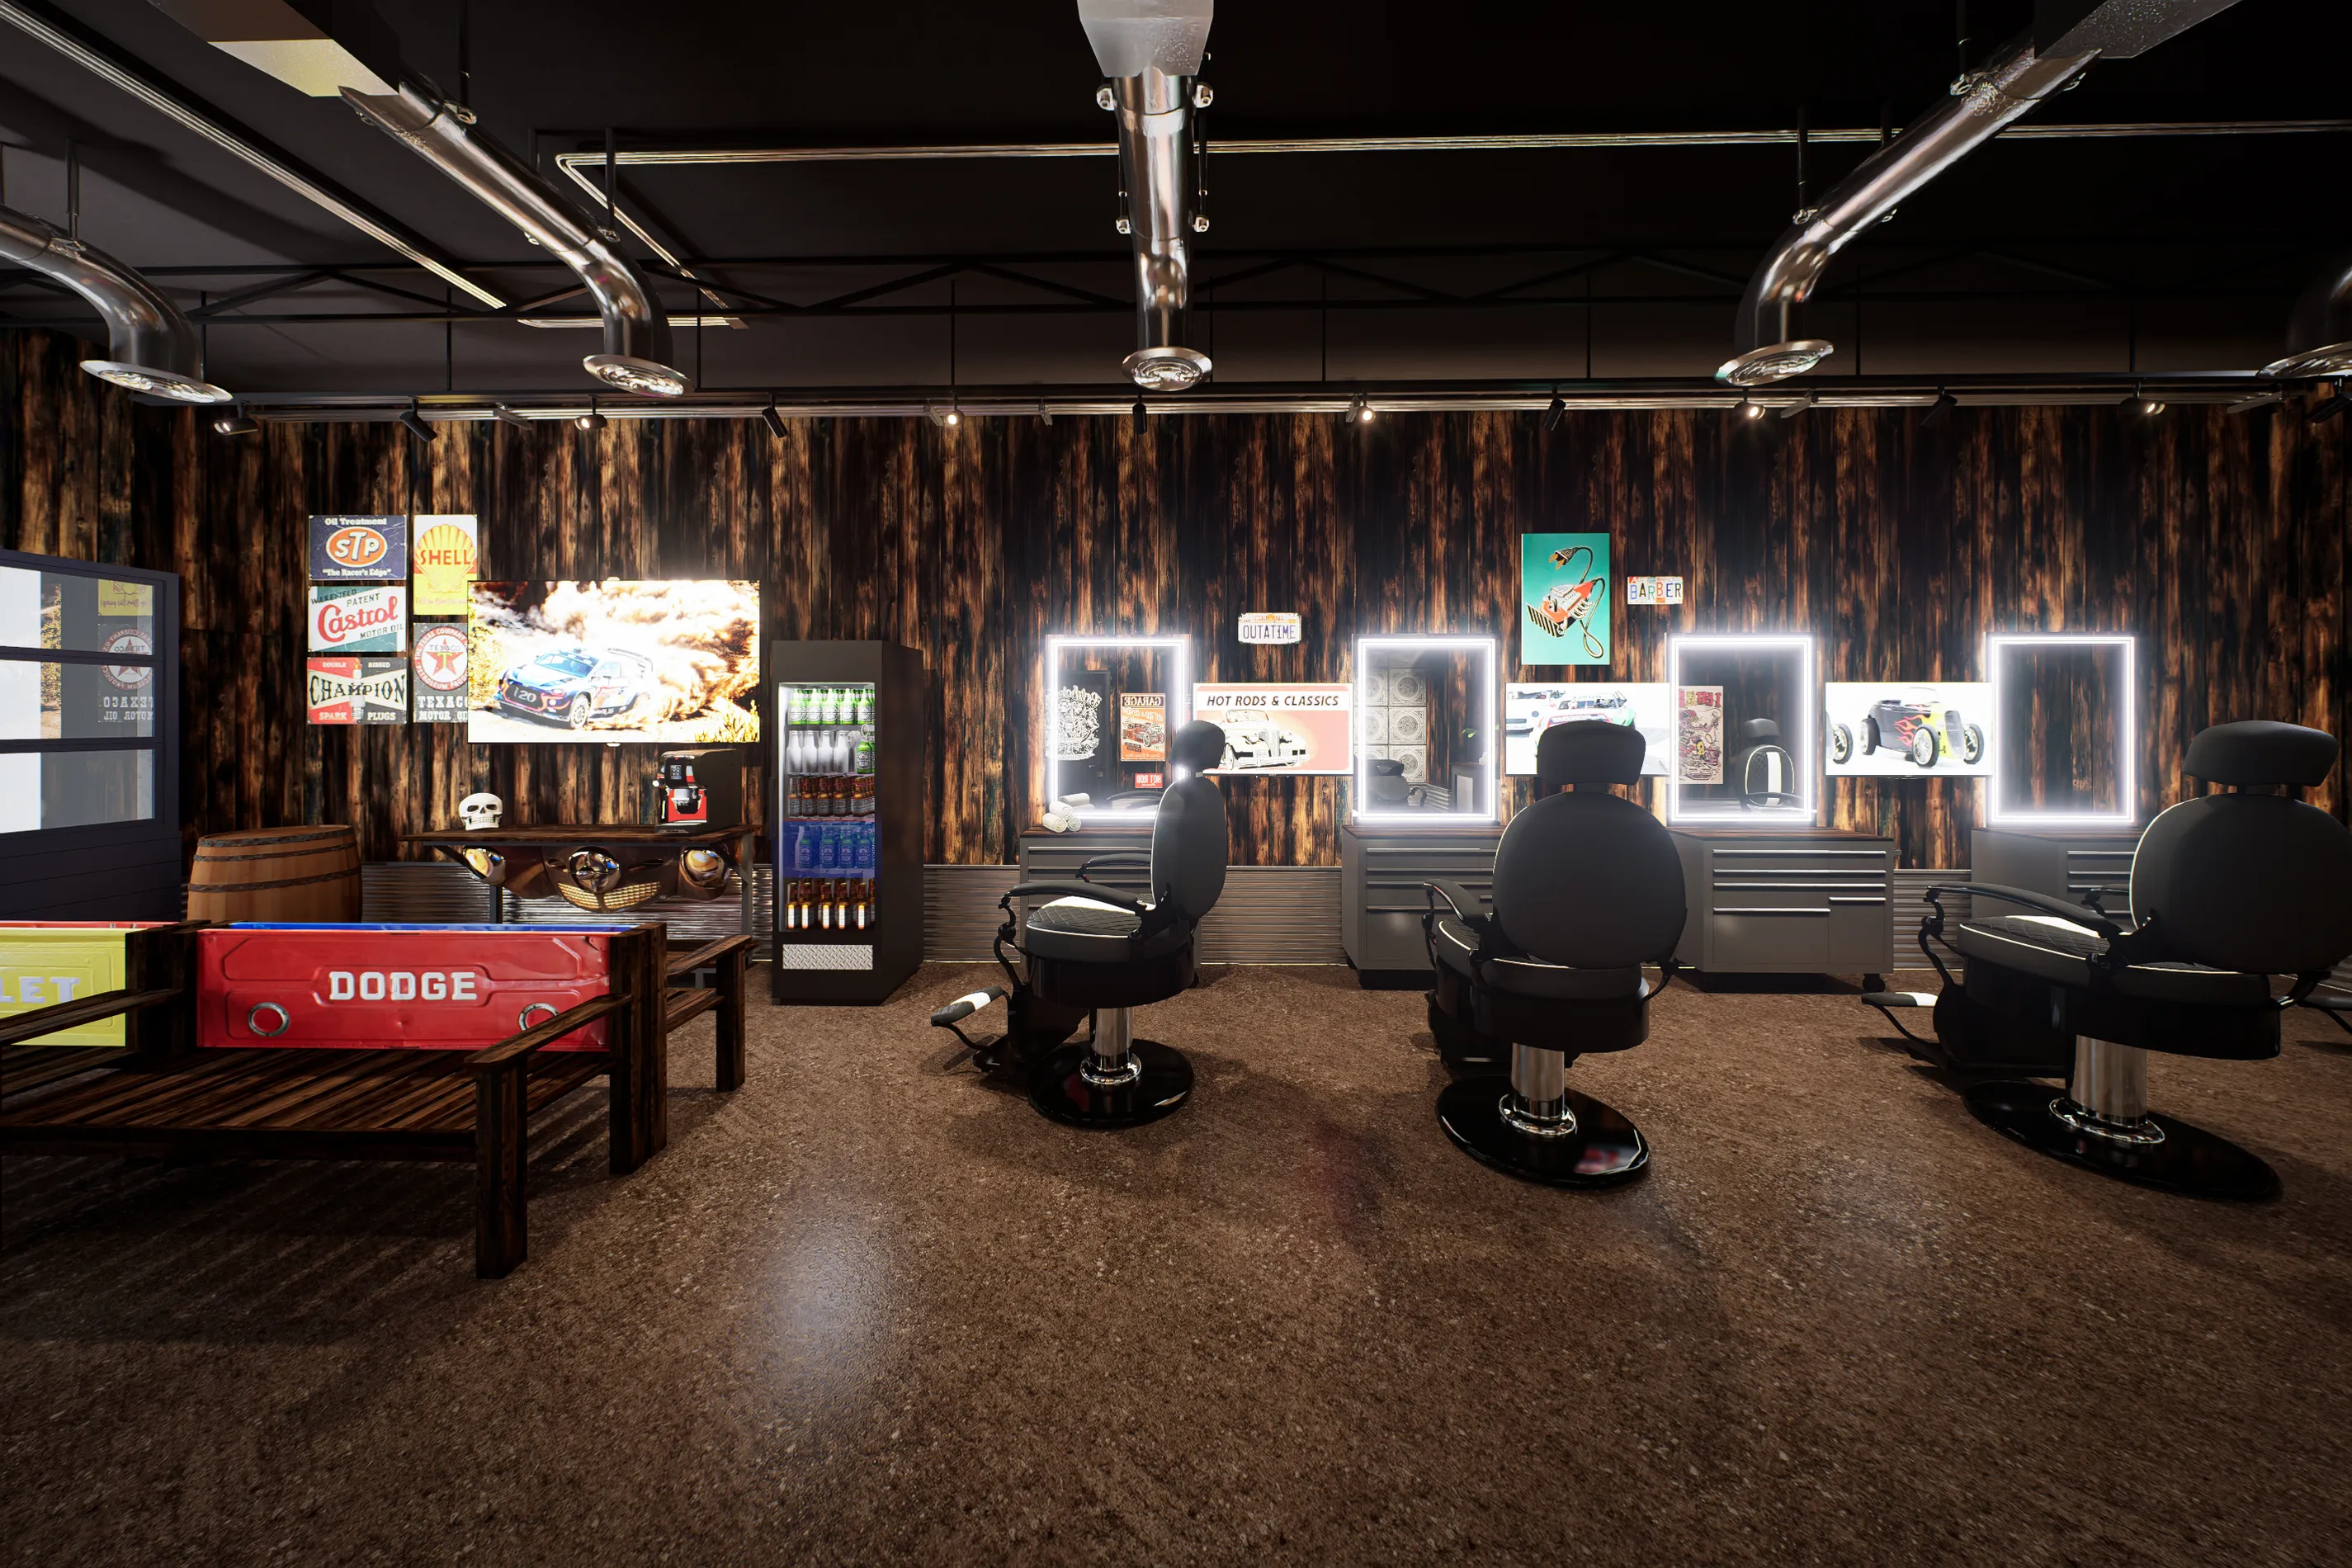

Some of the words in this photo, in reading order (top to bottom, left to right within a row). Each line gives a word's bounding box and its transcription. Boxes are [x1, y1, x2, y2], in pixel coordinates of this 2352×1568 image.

[334, 531, 380, 560] STP
[420, 549, 470, 564] SHELL
[311, 588, 357, 605] WAKEFIELD
[1631, 582, 1681, 600] BARBER
[347, 593, 380, 607] PATENT
[318, 596, 398, 642] Castrol
[360, 627, 388, 640] MOTOR
[390, 623, 404, 632] OIL
[1244, 625, 1296, 639] OUTATIME
[309, 674, 405, 706] CHAMPION
[1207, 696, 1231, 706] HOT
[1235, 696, 1267, 706] RODS
[1271, 696, 1279, 706] &
[1284, 696, 1339, 706] CLASSICS
[319, 712, 347, 720] SPARK
[367, 712, 396, 720] PLUGS
[419, 711, 451, 720] MOTOR
[328, 971, 477, 1000] DODGE
